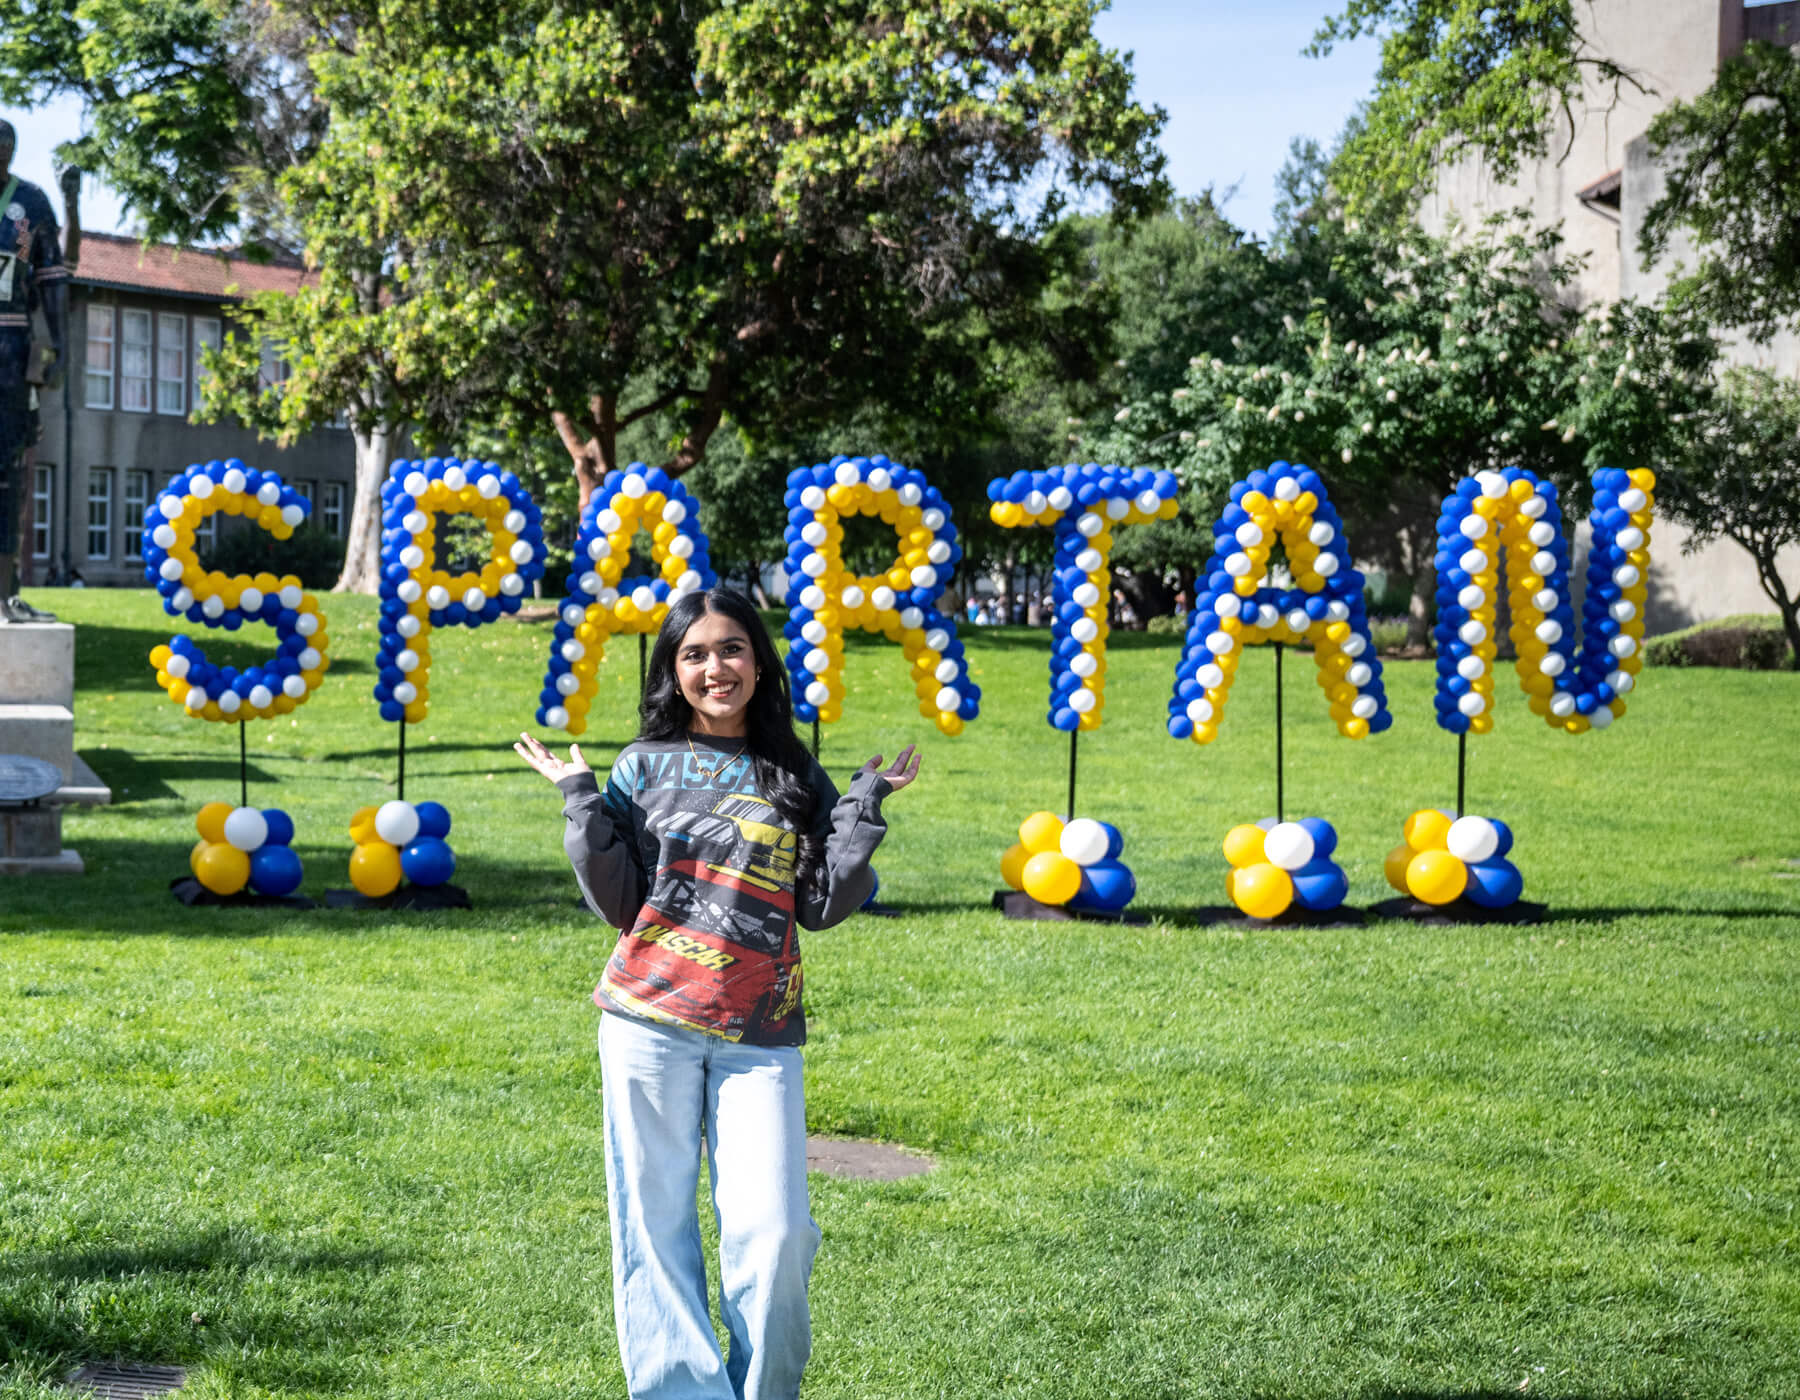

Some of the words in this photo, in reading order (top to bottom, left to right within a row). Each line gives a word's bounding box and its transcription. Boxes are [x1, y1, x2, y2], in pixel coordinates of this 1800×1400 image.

[143, 455, 1656, 744] SPARTAN
[635, 752, 757, 792] NASCA
[632, 925, 736, 971] NASCAR
